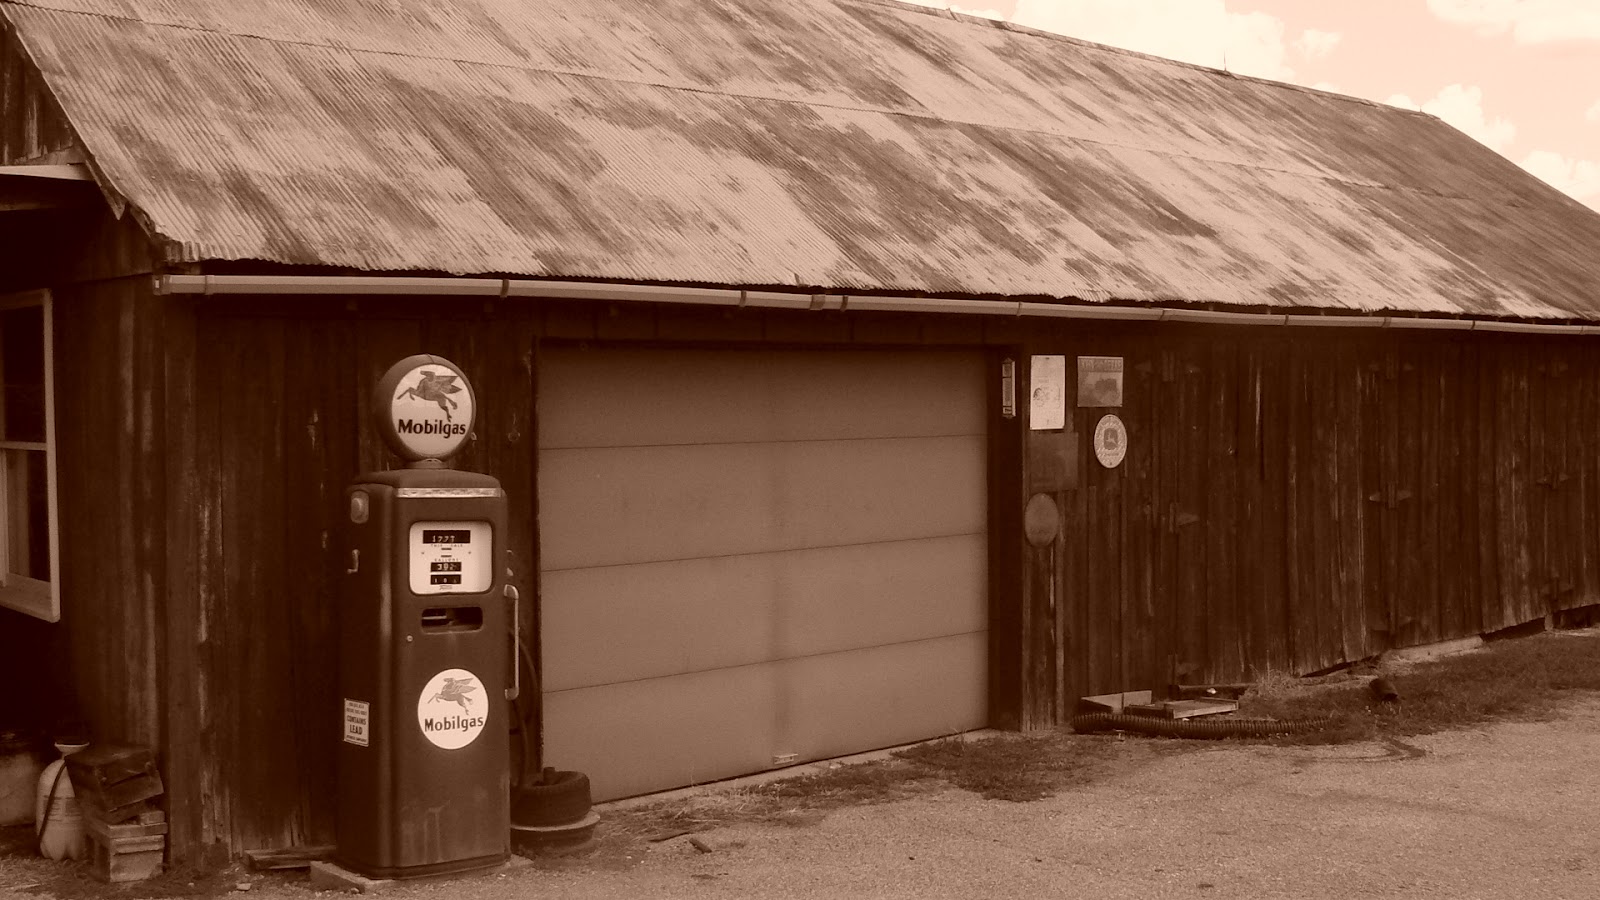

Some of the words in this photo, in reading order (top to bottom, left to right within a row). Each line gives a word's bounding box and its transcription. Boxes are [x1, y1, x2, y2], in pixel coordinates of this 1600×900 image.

[398, 419, 466, 439] Mobilgas
[346, 715, 367, 725] CONTAINS
[424, 715, 484, 732] Mobilgas
[349, 724, 363, 735] LEAD
